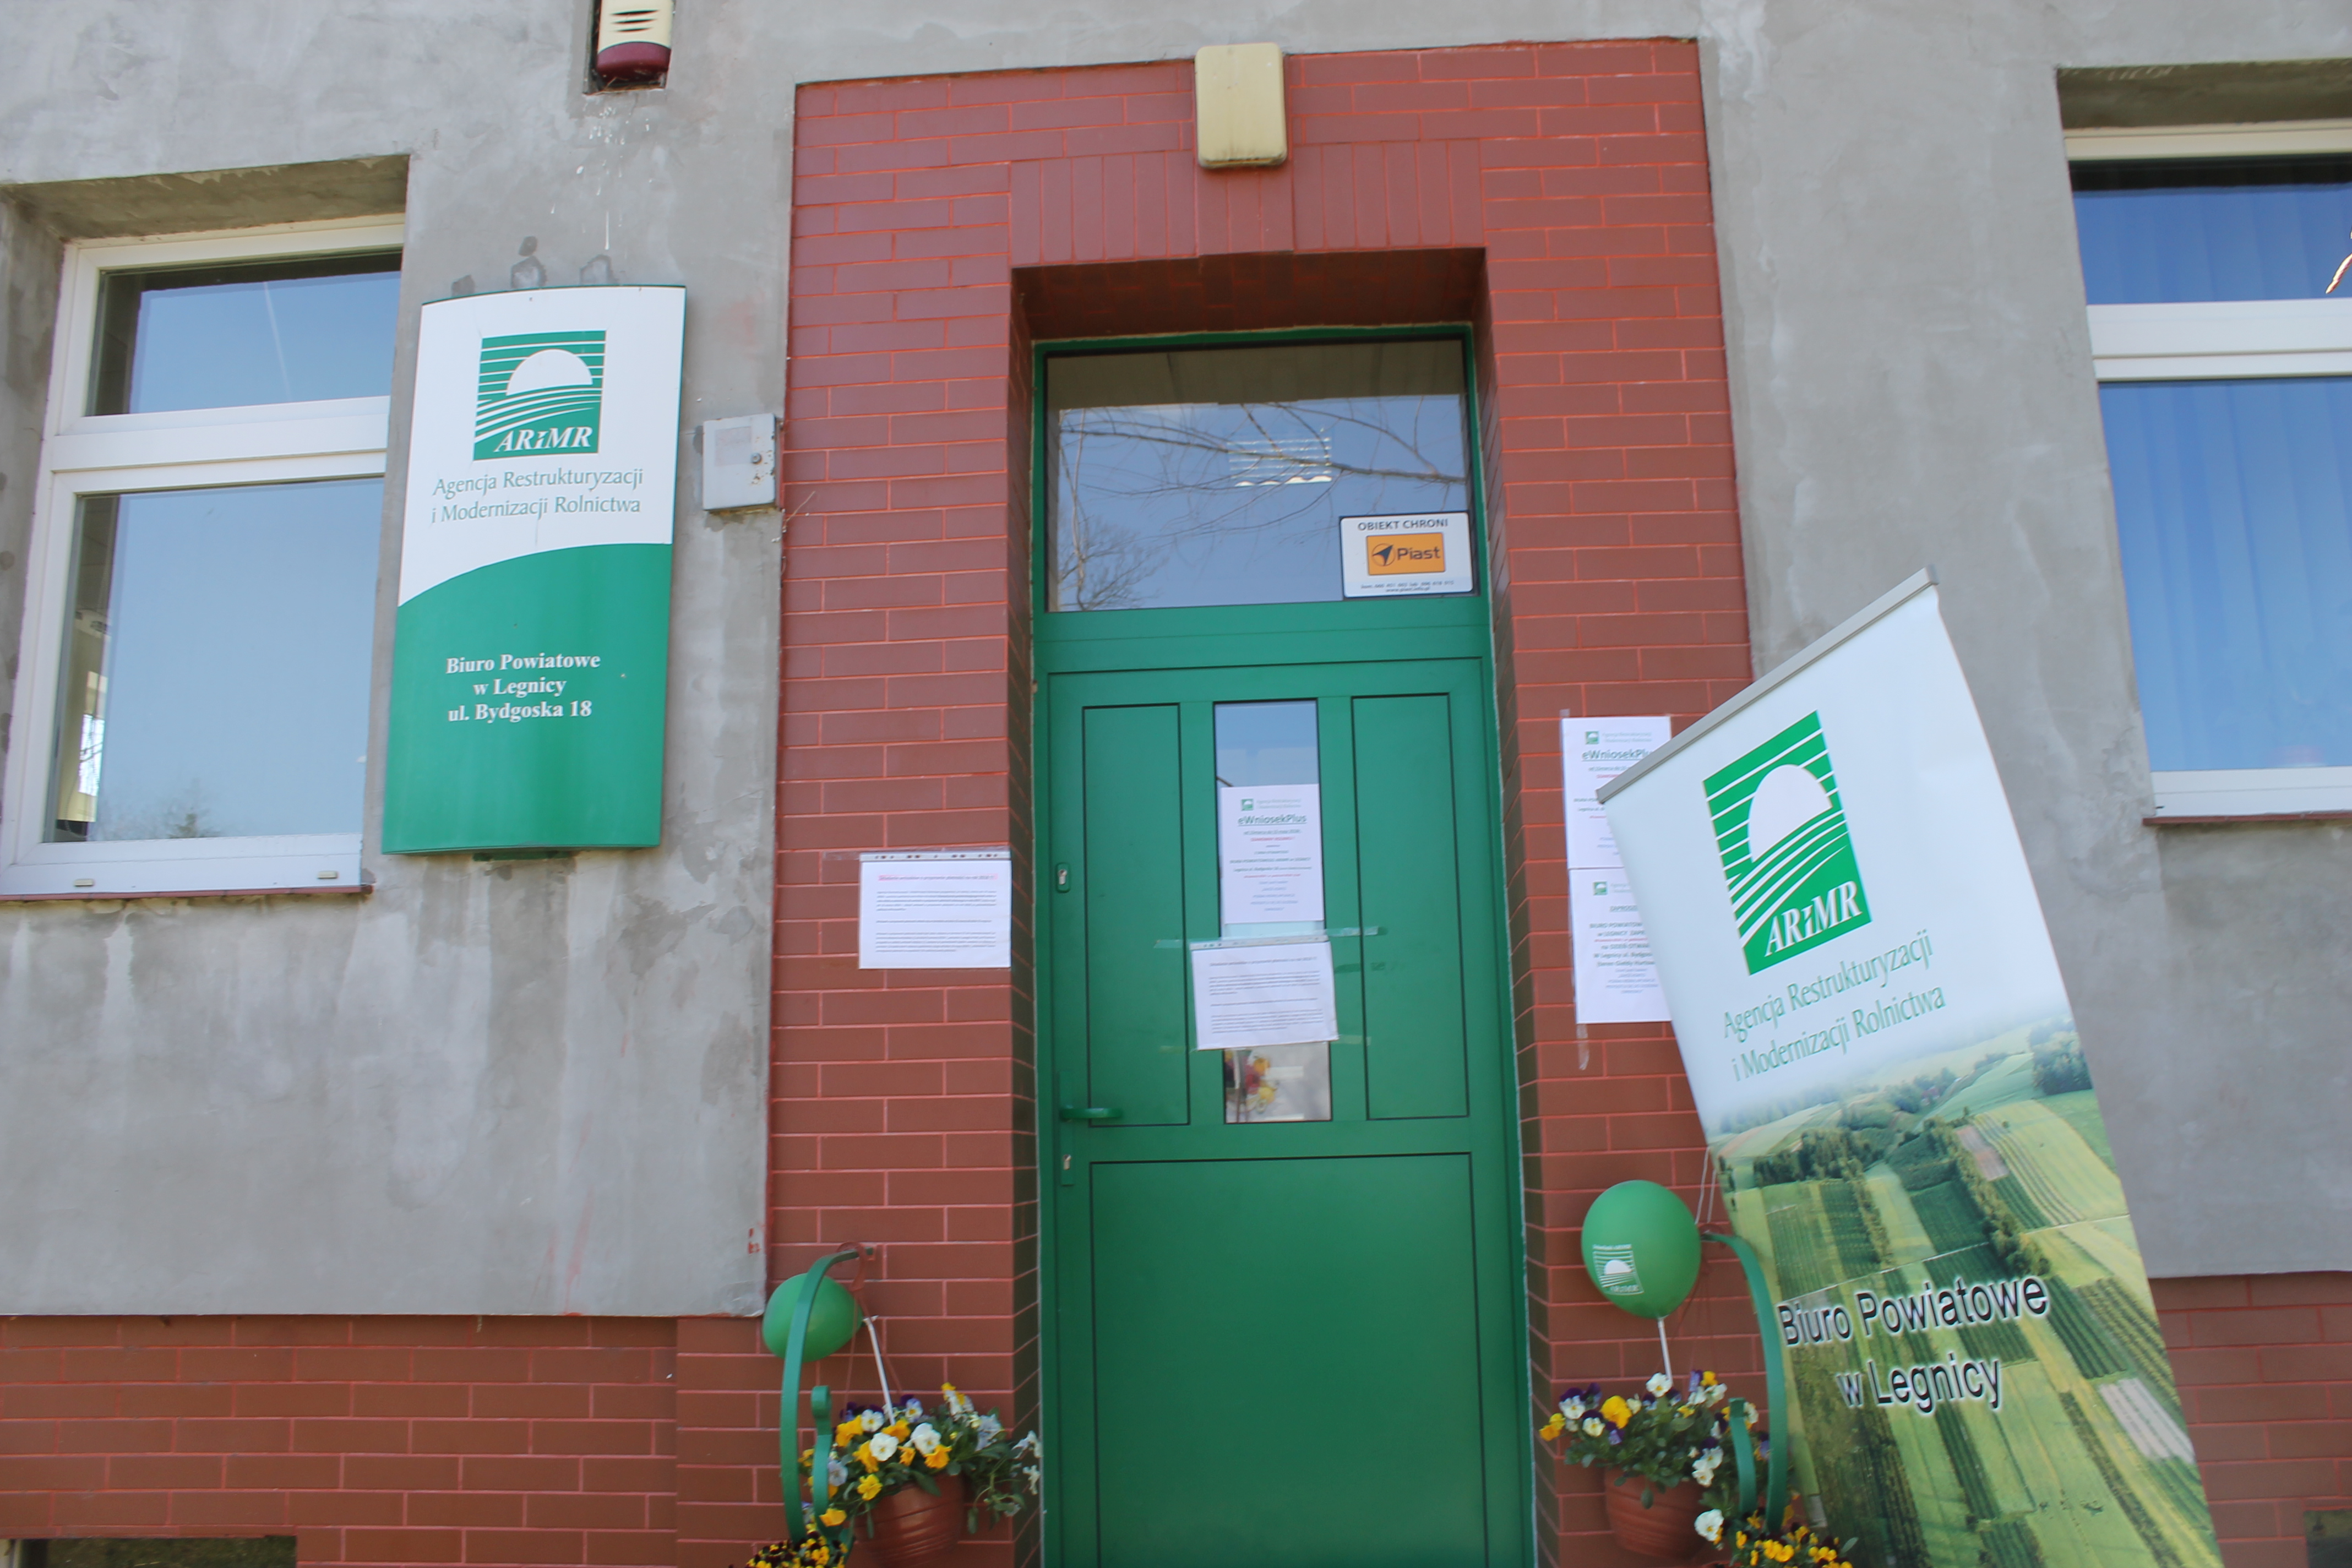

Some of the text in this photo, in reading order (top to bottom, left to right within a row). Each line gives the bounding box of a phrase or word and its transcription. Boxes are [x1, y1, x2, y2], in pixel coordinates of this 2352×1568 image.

[493, 426, 593, 453] ARiMR
[433, 467, 643, 499] Agencja Restrukturyzacji
[432, 495, 640, 524] i Modernizacji Rolnictwa
[1358, 519, 1448, 531] OBIEKT CHRONI
[1397, 547, 1440, 560] Piast
[445, 652, 601, 673] Biuro Powiatowe
[473, 677, 567, 698] w Legnicy
[448, 700, 592, 723] ul. Bydgoska 18
[1765, 880, 1863, 957] ARiMR
[1724, 929, 1933, 1043] Agencja Restrukturyzacji
[1731, 987, 1947, 1082] i Modernizacji Rolnictwa
[1777, 1277, 2050, 1346] Biuro Powiatowe
[1837, 1352, 2001, 1413] w Legnicy
